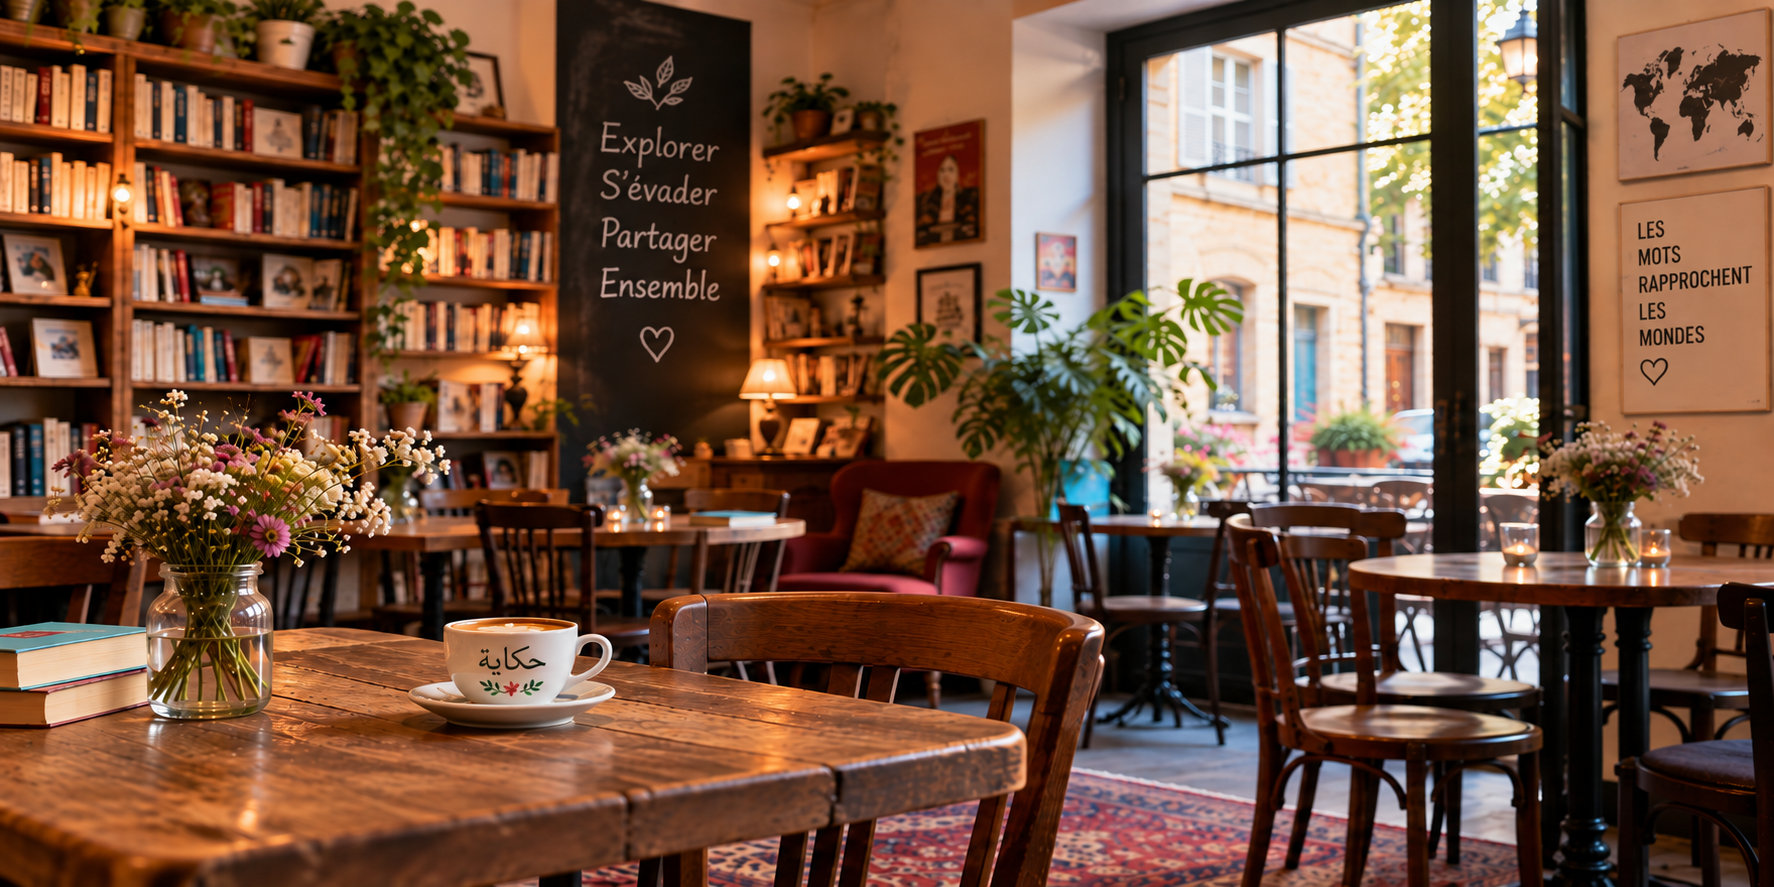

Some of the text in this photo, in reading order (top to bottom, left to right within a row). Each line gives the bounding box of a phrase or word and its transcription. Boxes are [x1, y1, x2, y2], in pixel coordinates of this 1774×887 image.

[600, 120, 720, 168] Explorer
[601, 216, 717, 264] Partager
[1638, 220, 1665, 240] LES
[1638, 245, 1681, 266] MOTS
[600, 267, 720, 301] Ensemble
[1639, 266, 1752, 294] RAPPROCHENT
[1639, 302, 1666, 321] LES
[1639, 325, 1705, 347] MONDES
[478, 645, 546, 676] حكاية
